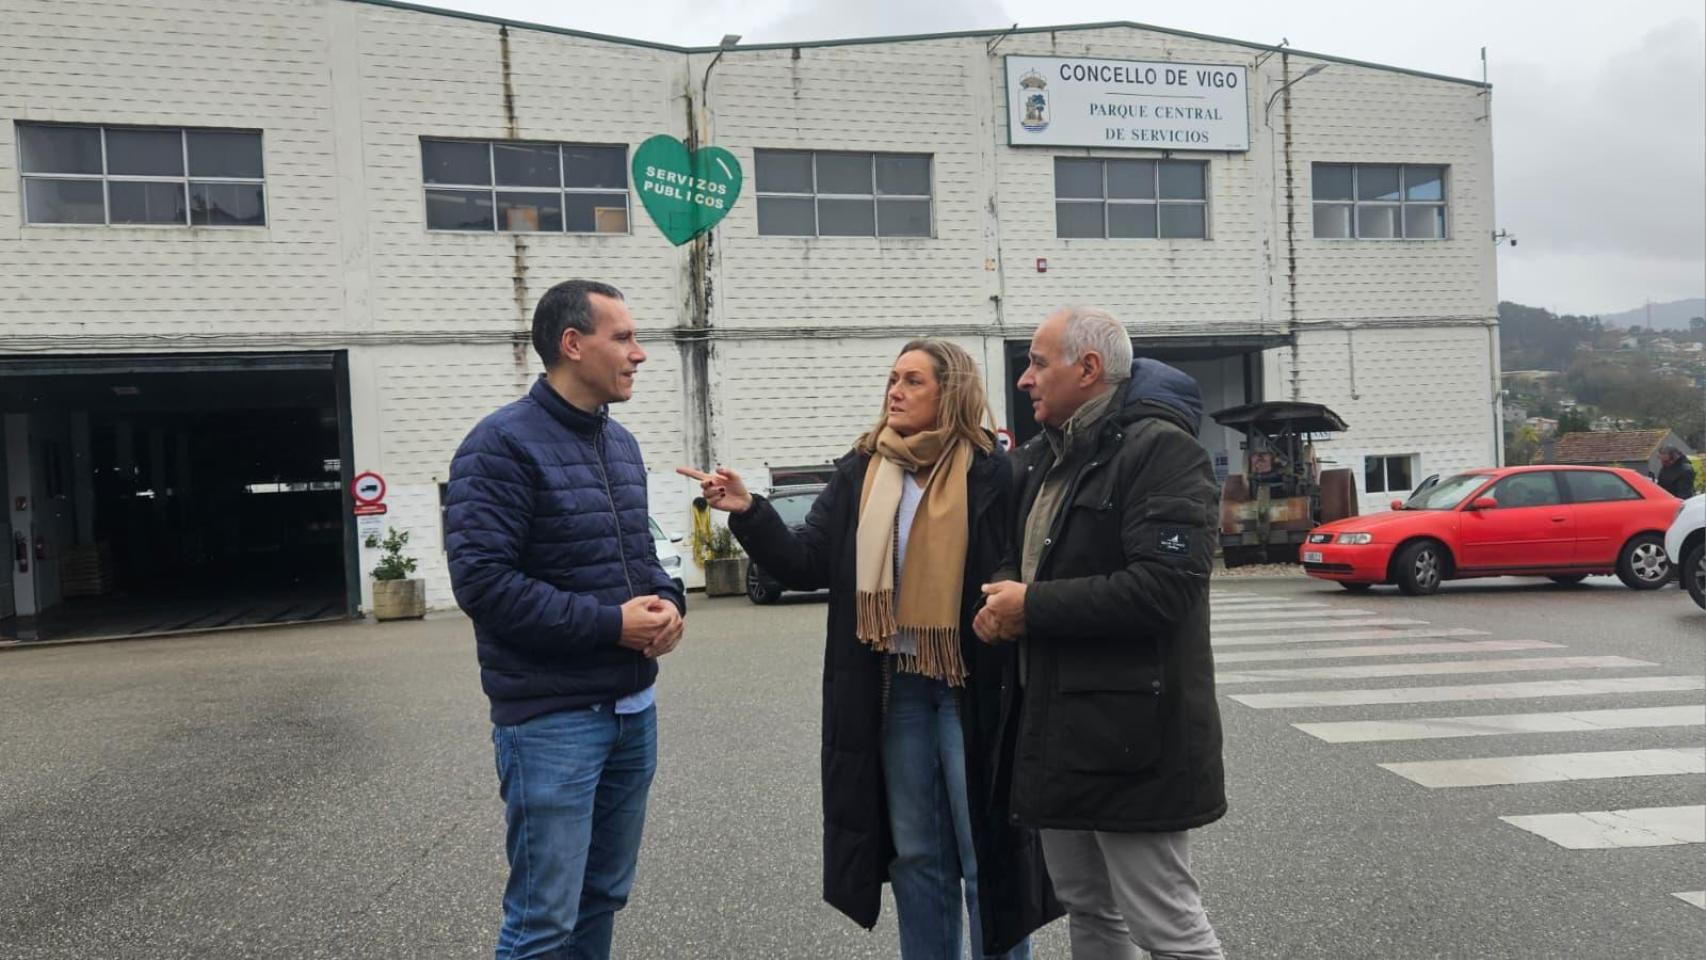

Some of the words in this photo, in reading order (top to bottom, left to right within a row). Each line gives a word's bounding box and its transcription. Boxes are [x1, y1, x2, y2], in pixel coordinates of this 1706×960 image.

[1059, 63, 1157, 85] CONCELLO
[1165, 69, 1188, 86] DE
[1196, 70, 1238, 89] VIGO
[1089, 102, 1149, 118] PARQUE
[1154, 106, 1223, 120] CENTRAL
[1105, 127, 1124, 141] DE
[1131, 128, 1209, 143] SERVICIOS
[646, 166, 727, 194] SERVIZOS
